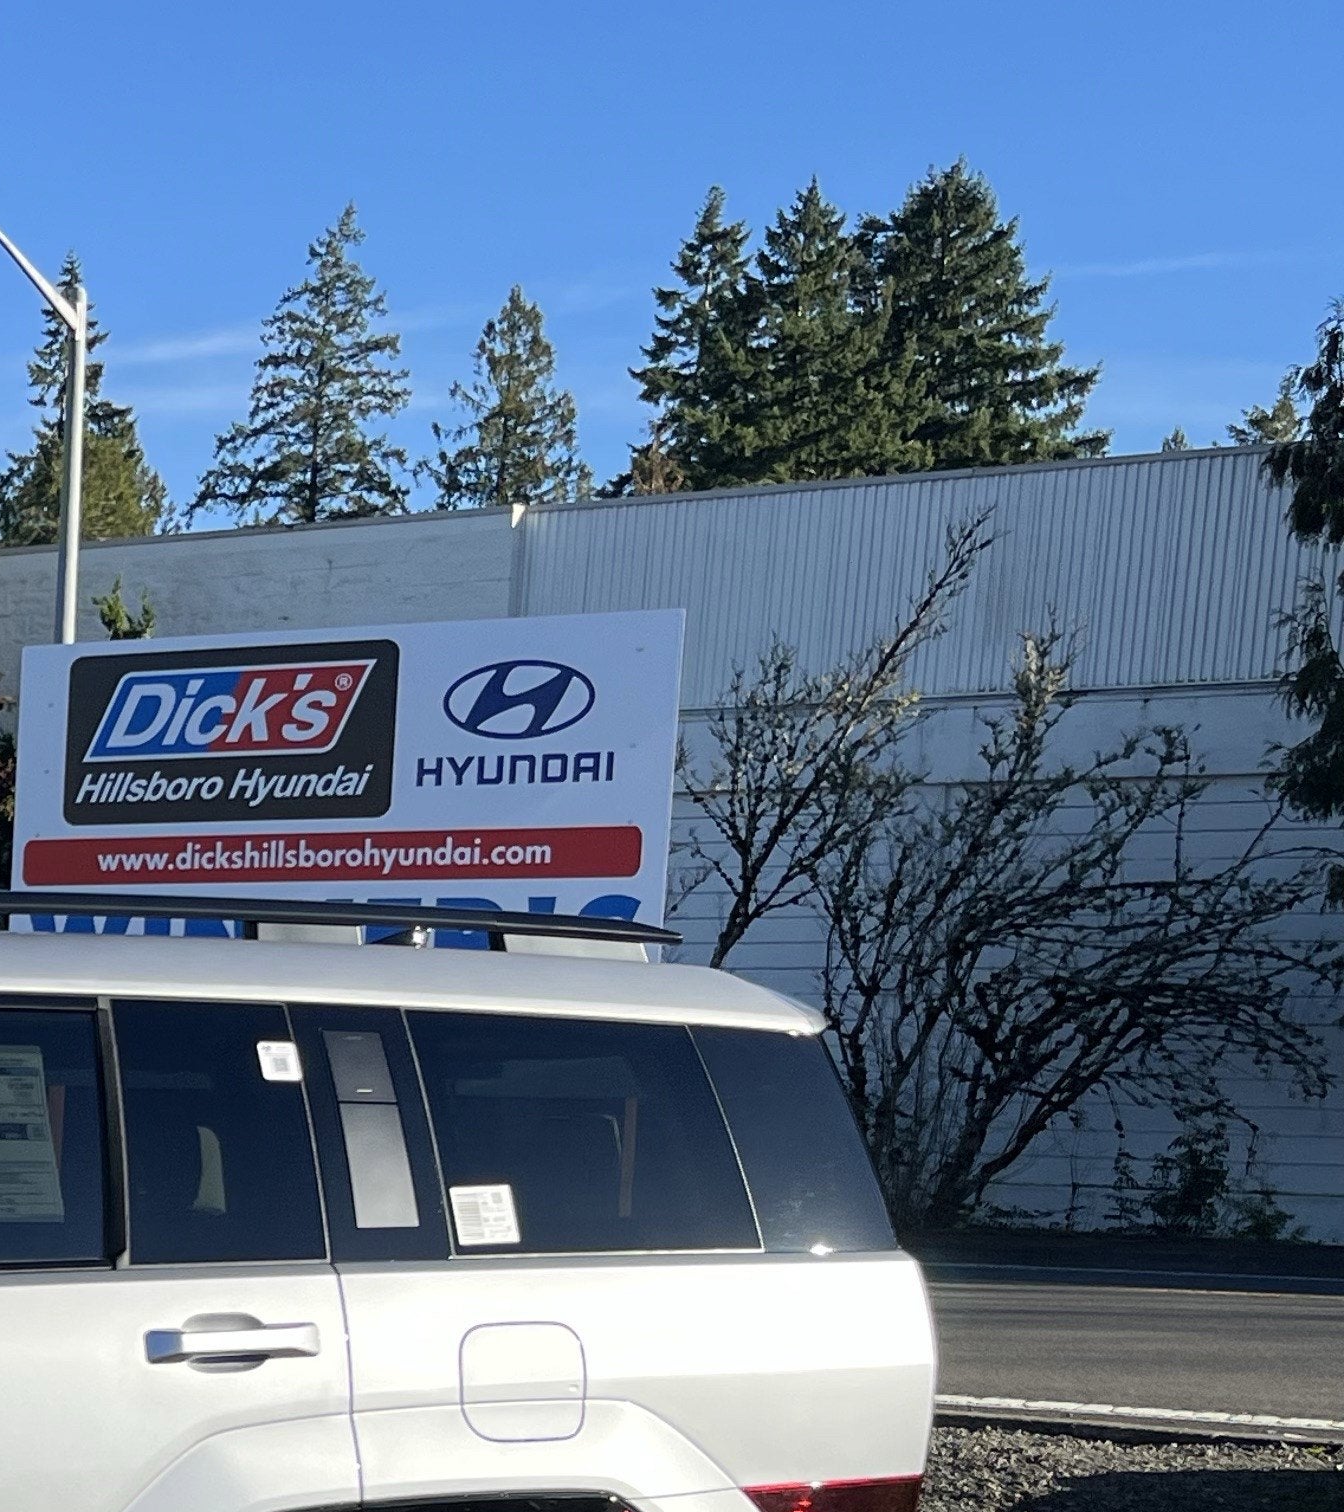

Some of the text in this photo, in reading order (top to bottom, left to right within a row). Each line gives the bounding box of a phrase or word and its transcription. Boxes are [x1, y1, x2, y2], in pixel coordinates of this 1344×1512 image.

[105, 673, 337, 748] Dick's
[74, 764, 374, 807] Hillsboro Hyundai
[416, 751, 615, 787] HYUNDAI
[97, 838, 552, 875] www.dickshillsborohyundai.com
